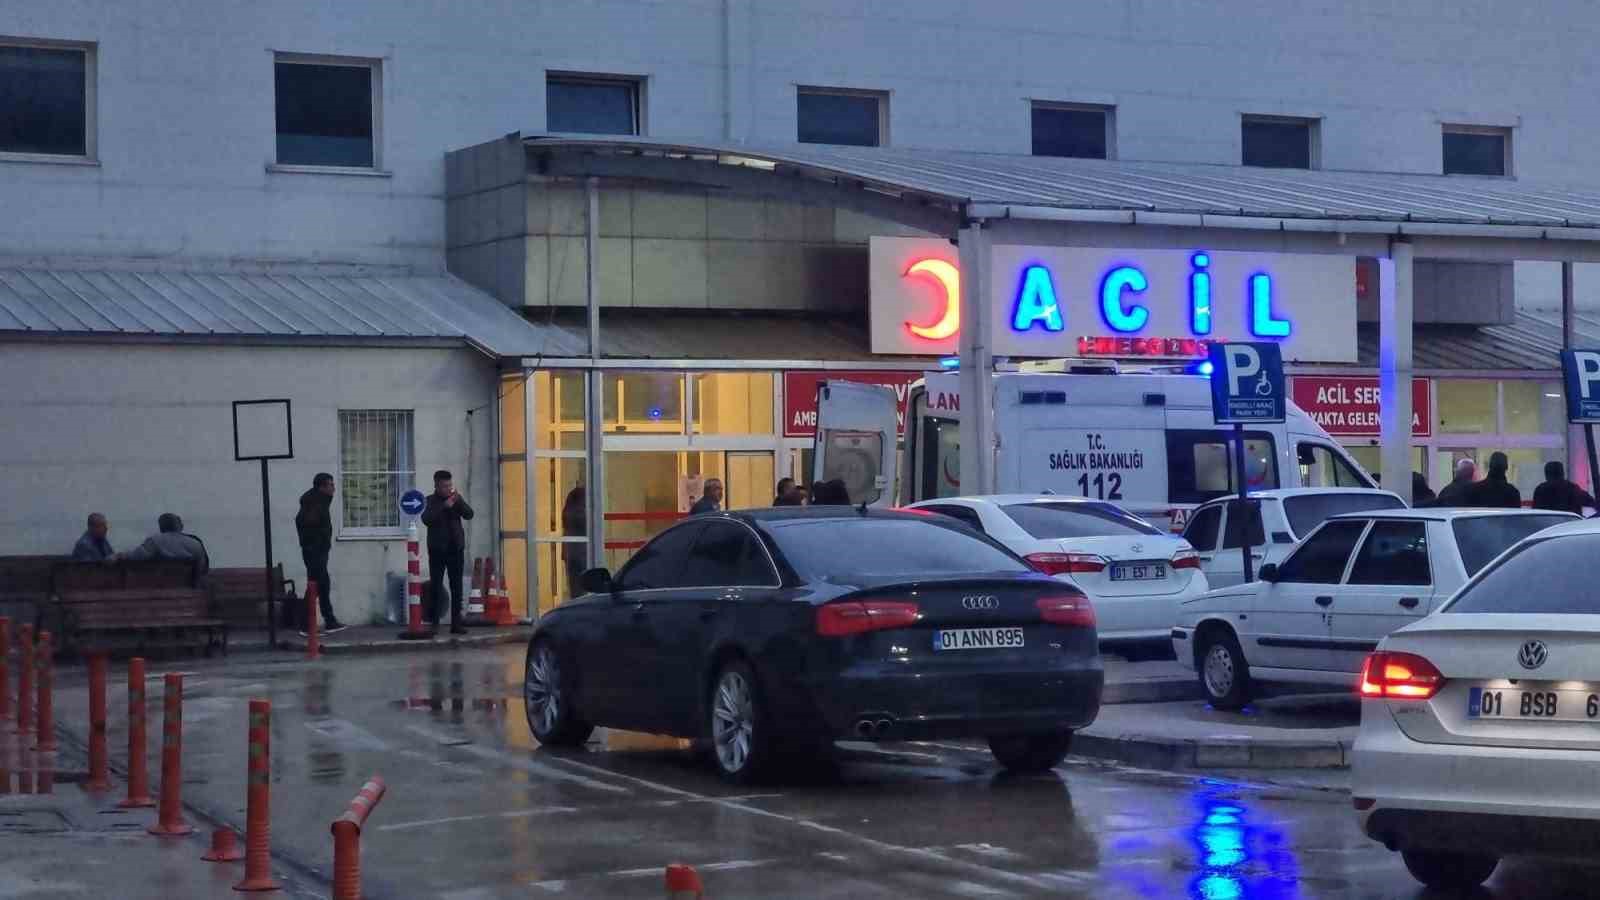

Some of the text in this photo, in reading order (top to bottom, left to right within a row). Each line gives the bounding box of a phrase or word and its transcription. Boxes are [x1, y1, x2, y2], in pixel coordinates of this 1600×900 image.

[1012, 249, 1292, 337] ACİL
[1224, 345, 1260, 396] P
[926, 391, 960, 411] LAN
[1316, 383, 1381, 404] ACİL SER
[1087, 433, 1106, 450] T.C.
[1049, 449, 1144, 470] SAĞLIK BAKANLIĞI
[1078, 472, 1123, 500] 112
[1116, 567, 1126, 578] 01
[1133, 566, 1148, 578] EST
[942, 631, 958, 648] 01
[962, 630, 994, 647] ANN
[996, 629, 1023, 646] 895
[1481, 691, 1599, 718] 01 BSB 6
